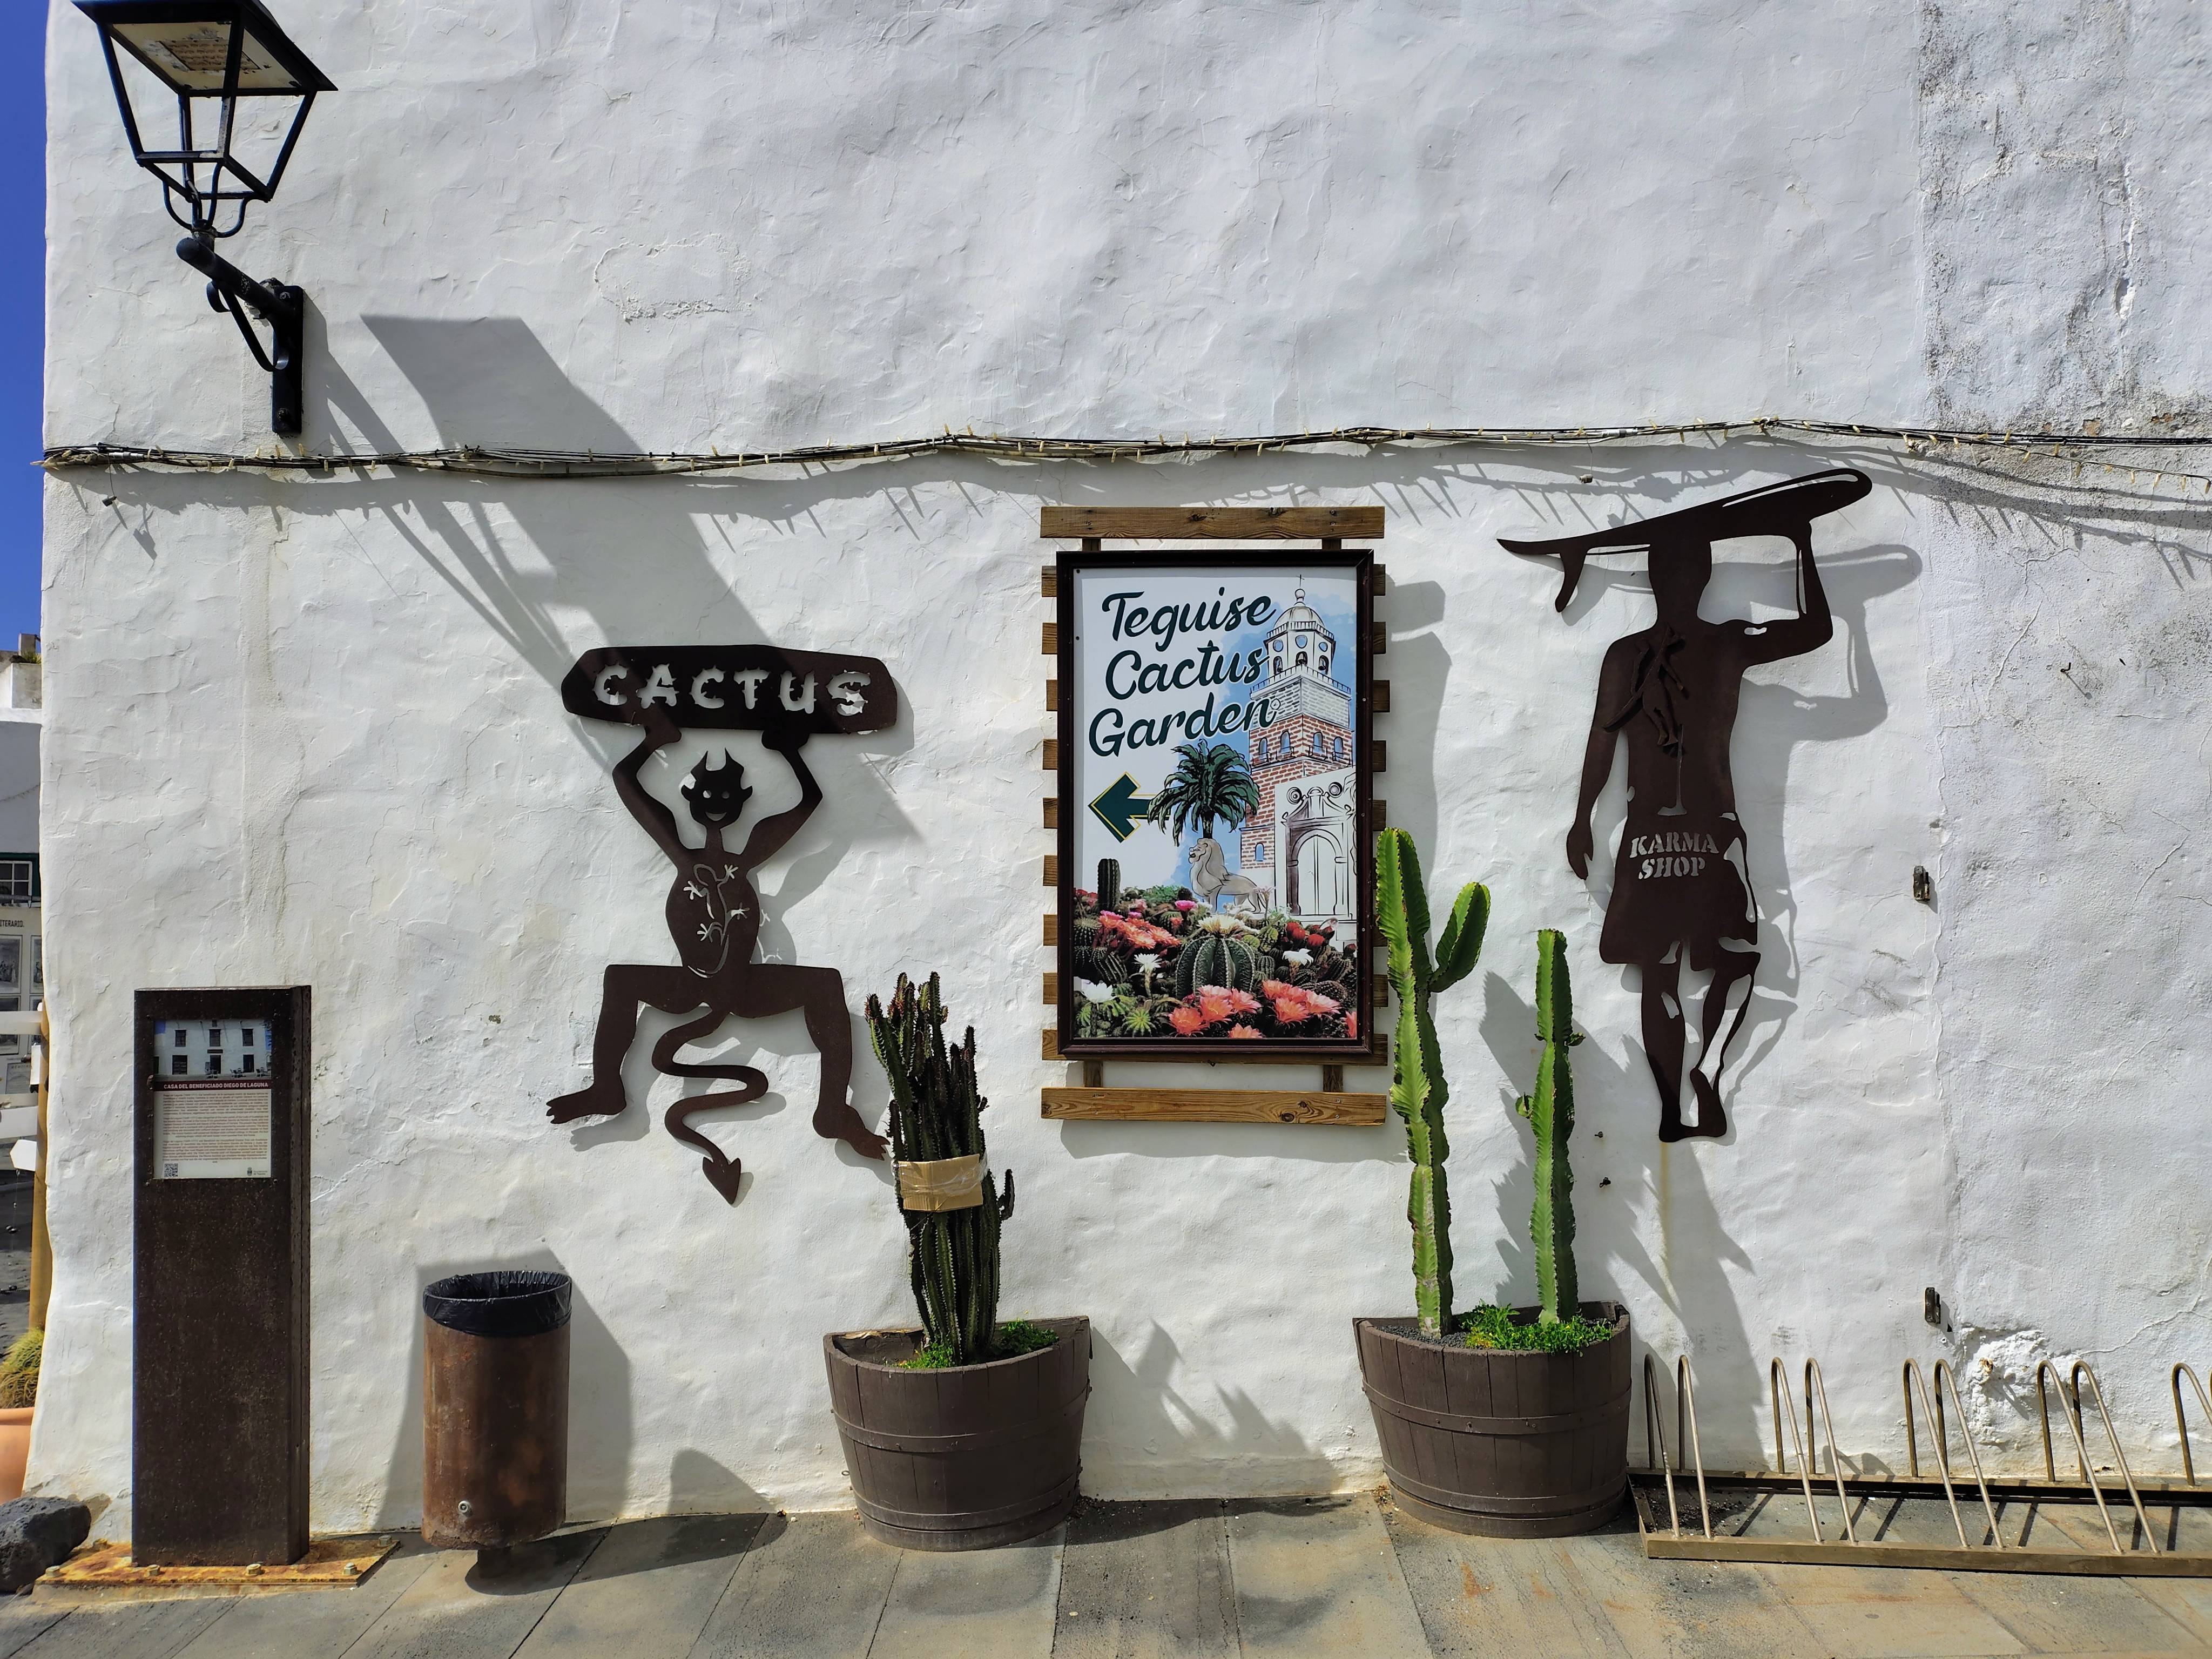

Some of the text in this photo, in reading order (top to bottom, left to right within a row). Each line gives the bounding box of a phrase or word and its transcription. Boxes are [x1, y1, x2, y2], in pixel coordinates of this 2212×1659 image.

[1102, 586, 1277, 652] Teguise
[592, 660, 872, 717] CACTUS
[1105, 640, 1270, 700] Cactus
[1088, 692, 1279, 757] Garden
[1629, 832, 1719, 858] KARMA
[1638, 857, 1706, 879] SHOP
